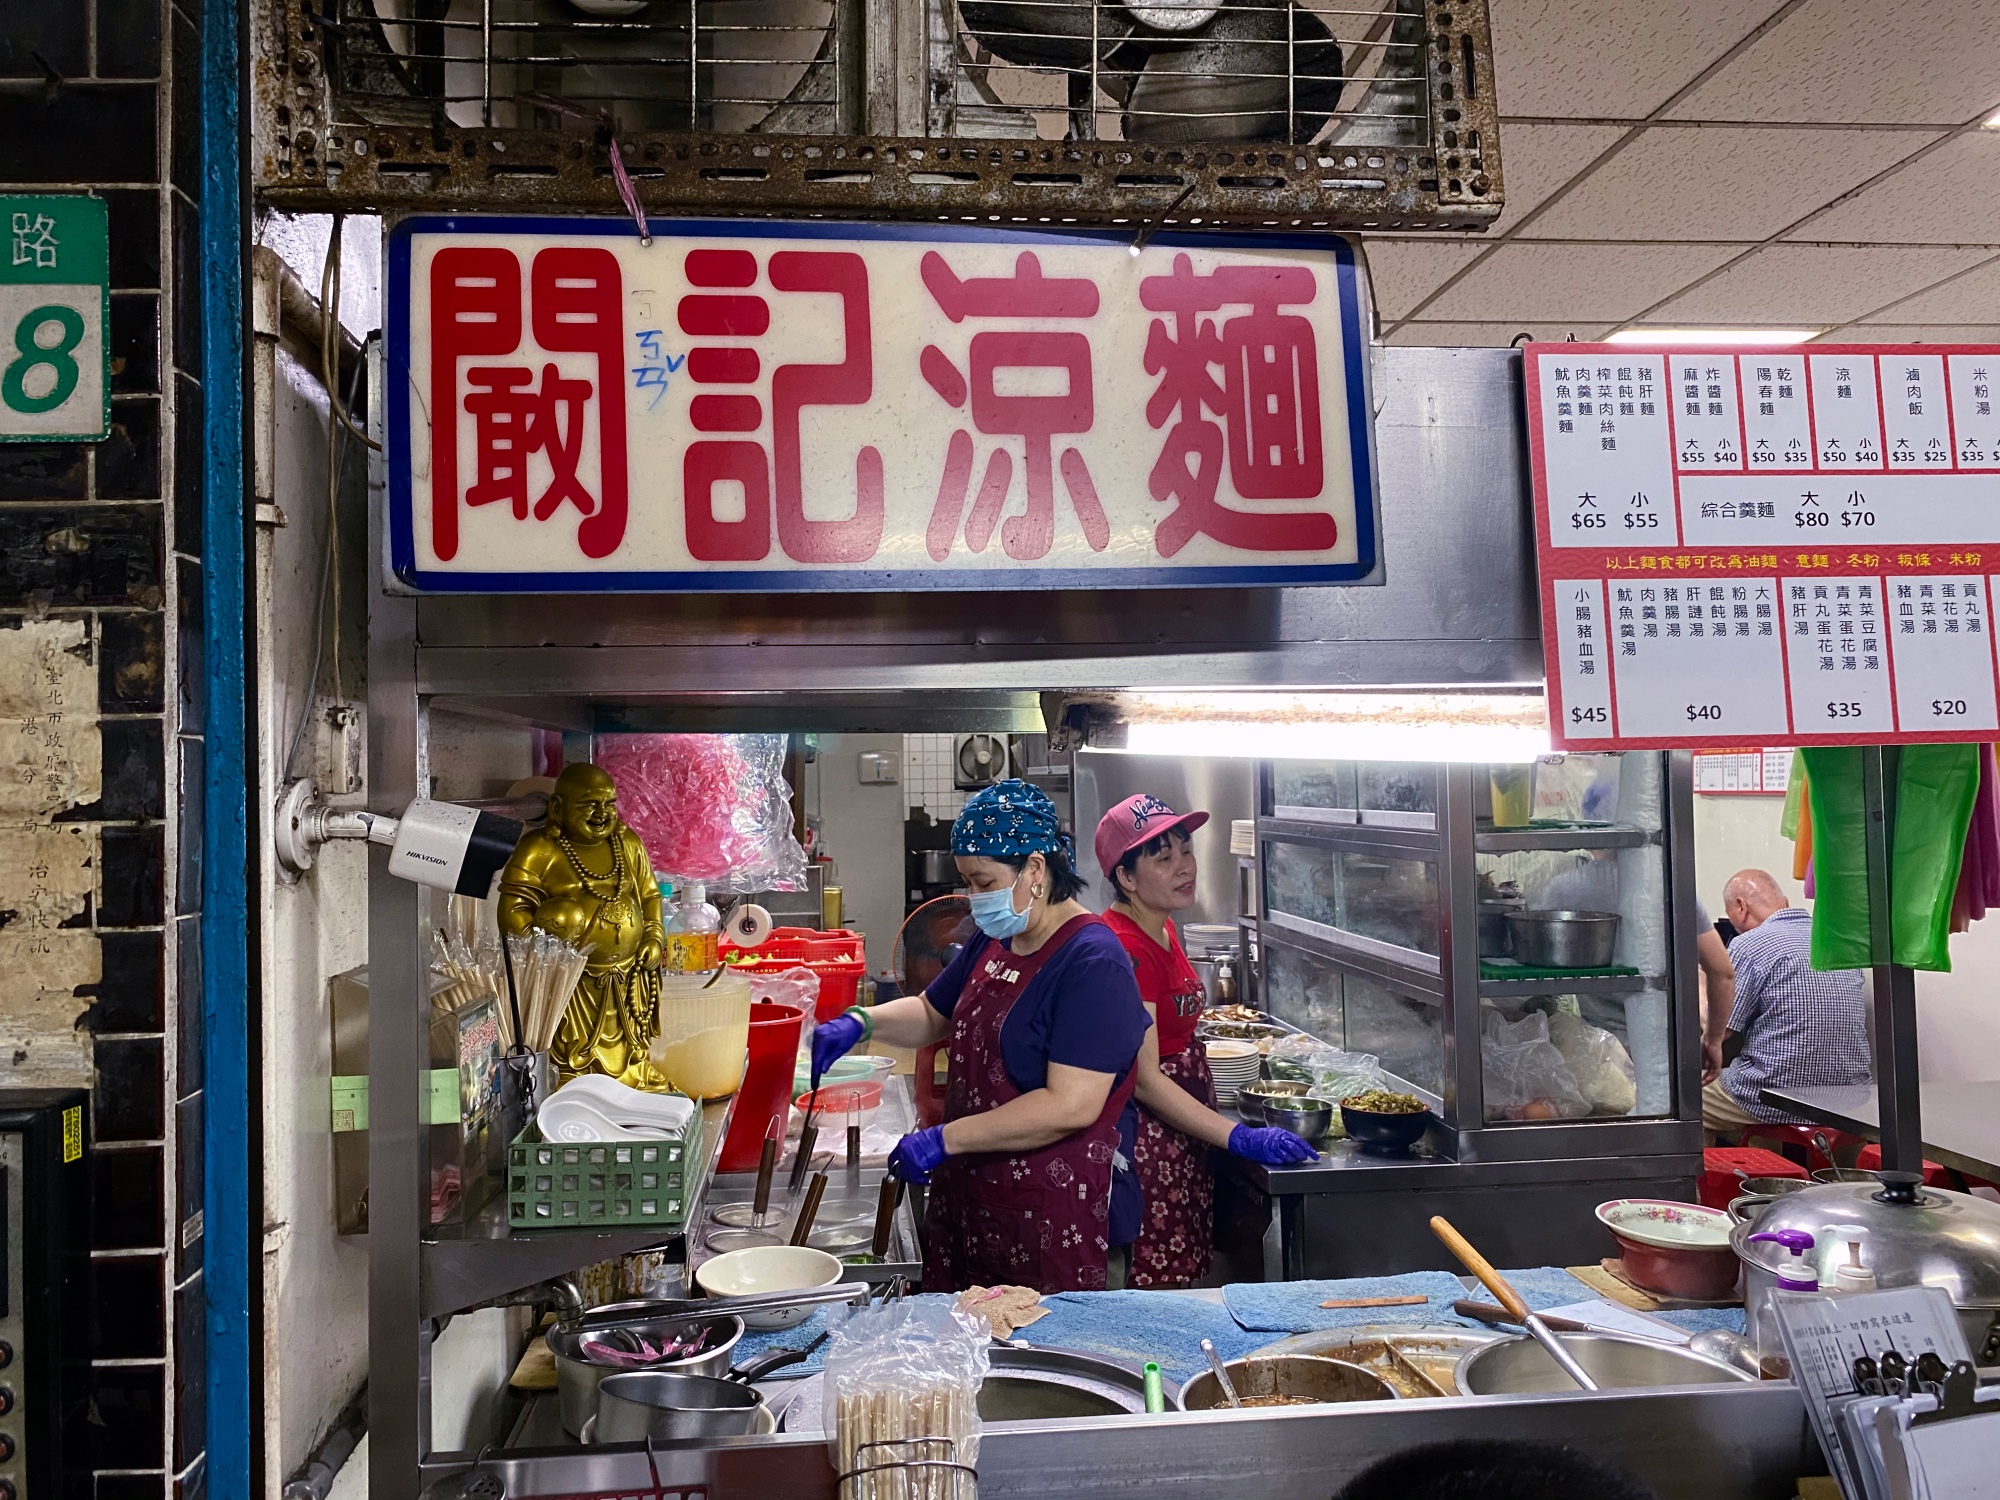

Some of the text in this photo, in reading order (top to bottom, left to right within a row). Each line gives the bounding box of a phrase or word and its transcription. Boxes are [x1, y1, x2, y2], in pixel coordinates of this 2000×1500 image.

[12, 212, 60, 268] 路
[1, 303, 85, 414] 8
[1777, 367, 1793, 399] 乾麵
[1835, 367, 1852, 399] 涼麵
[430, 247, 1338, 563] 闞記涼麵
[1555, 367, 1574, 434] 魷魚羹麵
[1575, 367, 1593, 416] 肉羹麵
[1597, 367, 1616, 451] 榨菜肉絲麵
[1617, 367, 1634, 416] 餛飩麵
[1638, 367, 1655, 416] 豬肝麵
[1683, 367, 1701, 416] 麻醬麵
[1705, 367, 1723, 416] 炸醬麵
[1756, 367, 1775, 416] 陽春麵
[1905, 367, 1923, 416] 滷肉飯
[1973, 367, 1990, 416] 米粉湯
[1682, 452, 1738, 463] $55 $40
[1686, 438, 1731, 450] 大 小
[1752, 452, 1807, 463] $50 $35
[1756, 438, 1801, 450] 大 小
[1823, 451, 1878, 463] $50 $40
[1827, 438, 1872, 449] 大 小
[1892, 451, 1947, 462] $35 $25
[1896, 437, 1941, 449] 大 小
[1961, 451, 1984, 462] $35
[1965, 437, 1978, 449] 大
[1571, 512, 1659, 528] $65 $55
[1578, 491, 1649, 508] 大 小
[1701, 501, 1776, 519] 綜合羹麵
[1794, 511, 1875, 527] $80 $70
[1801, 490, 1866, 507] 大 小
[1575, 587, 1594, 675] 小腸豬血湯
[1617, 587, 1636, 656] 魷魚羹湯
[1640, 587, 1658, 638] 肉羹湯
[1663, 587, 1681, 638] 豬腸湯
[1709, 586, 1727, 637] 餛飩湯
[1732, 586, 1750, 636] 粉腸湯
[1755, 586, 1772, 636] 大腸湯
[1791, 586, 1809, 635] 豬肝湯
[1813, 585, 1834, 670] 貢丸蛋花湯
[1836, 585, 1857, 670] 青菜蛋花湯
[1858, 585, 1879, 670] 青菜豆腐湯
[1897, 584, 1915, 634] 豬血湯
[1919, 584, 1937, 634] 青菜湯
[1941, 583, 1959, 633] 蛋花湯
[1963, 583, 1981, 633] 貢丸湯
[1572, 706, 1607, 724] $45
[1686, 704, 1722, 722] $40
[1827, 701, 1862, 719] $35
[1932, 699, 1967, 716] $20
[405, 850, 448, 866] HIKVISION
